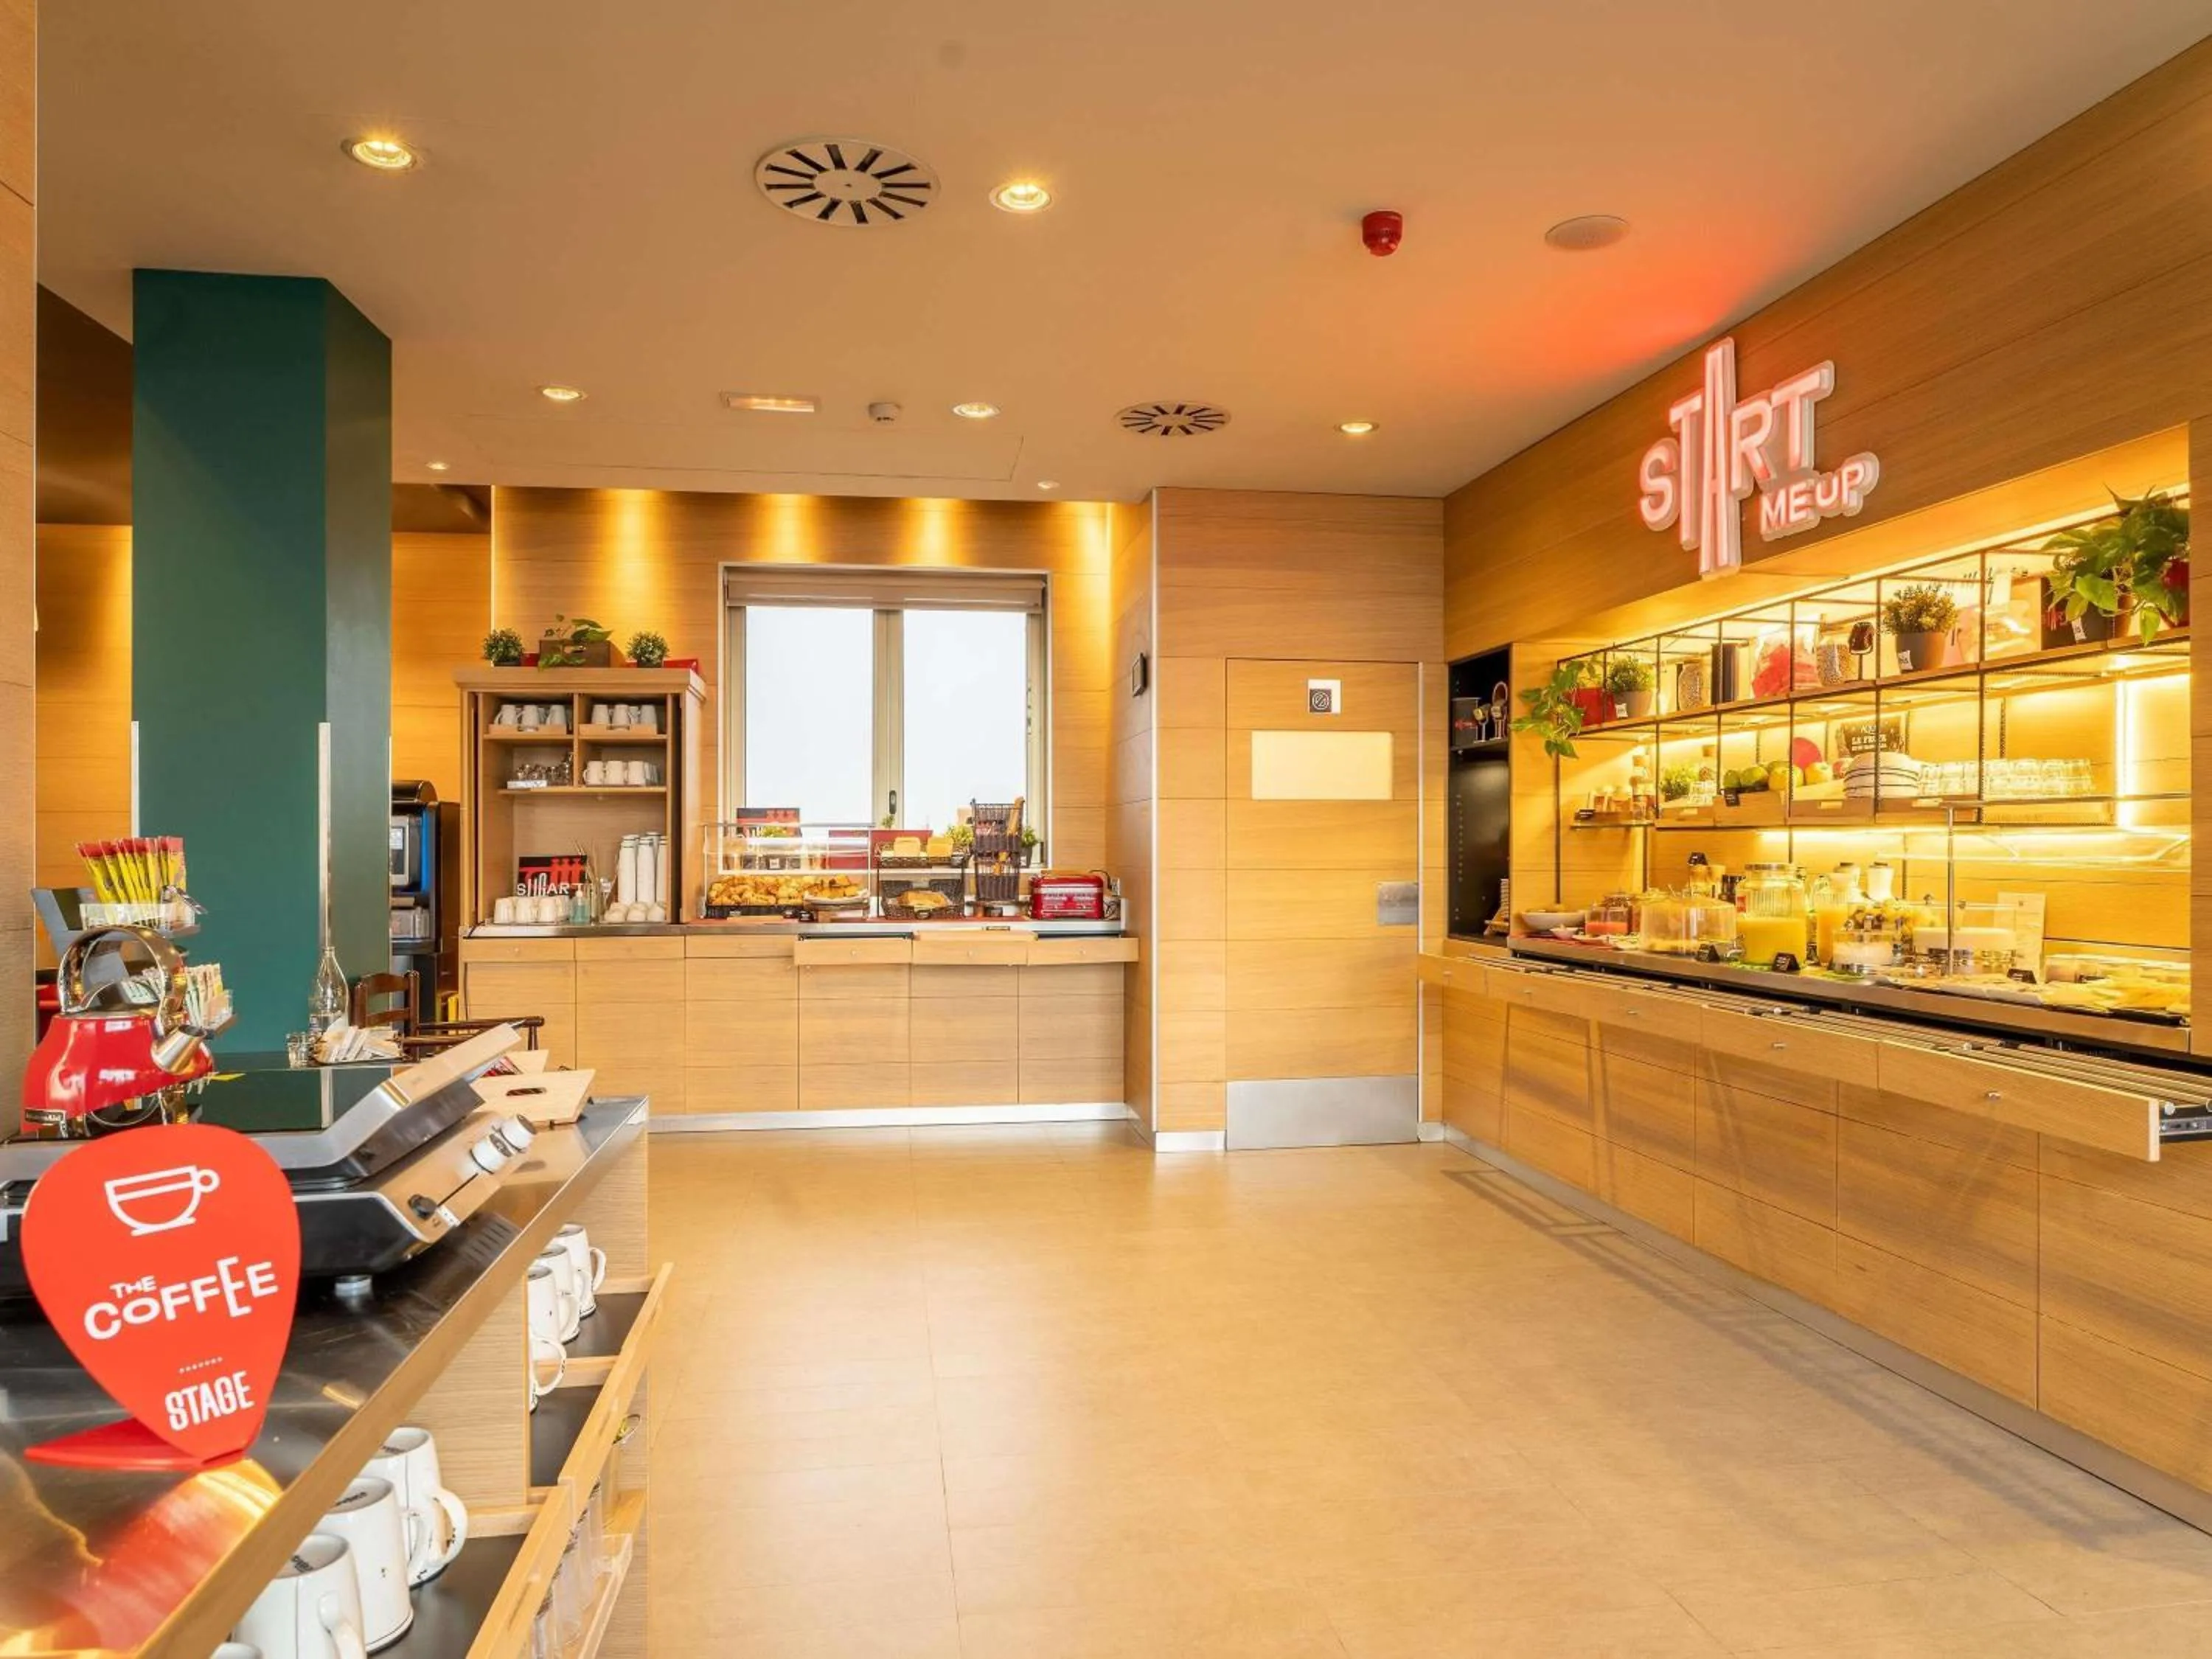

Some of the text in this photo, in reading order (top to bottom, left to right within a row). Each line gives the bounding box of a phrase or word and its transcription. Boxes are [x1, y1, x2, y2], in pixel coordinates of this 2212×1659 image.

[1638, 335, 1834, 578] START
[1759, 453, 1878, 539] ME UP
[83, 1256, 279, 1340] COFFEE
[109, 1276, 157, 1298] THE
[164, 1371, 255, 1431] STAGE
